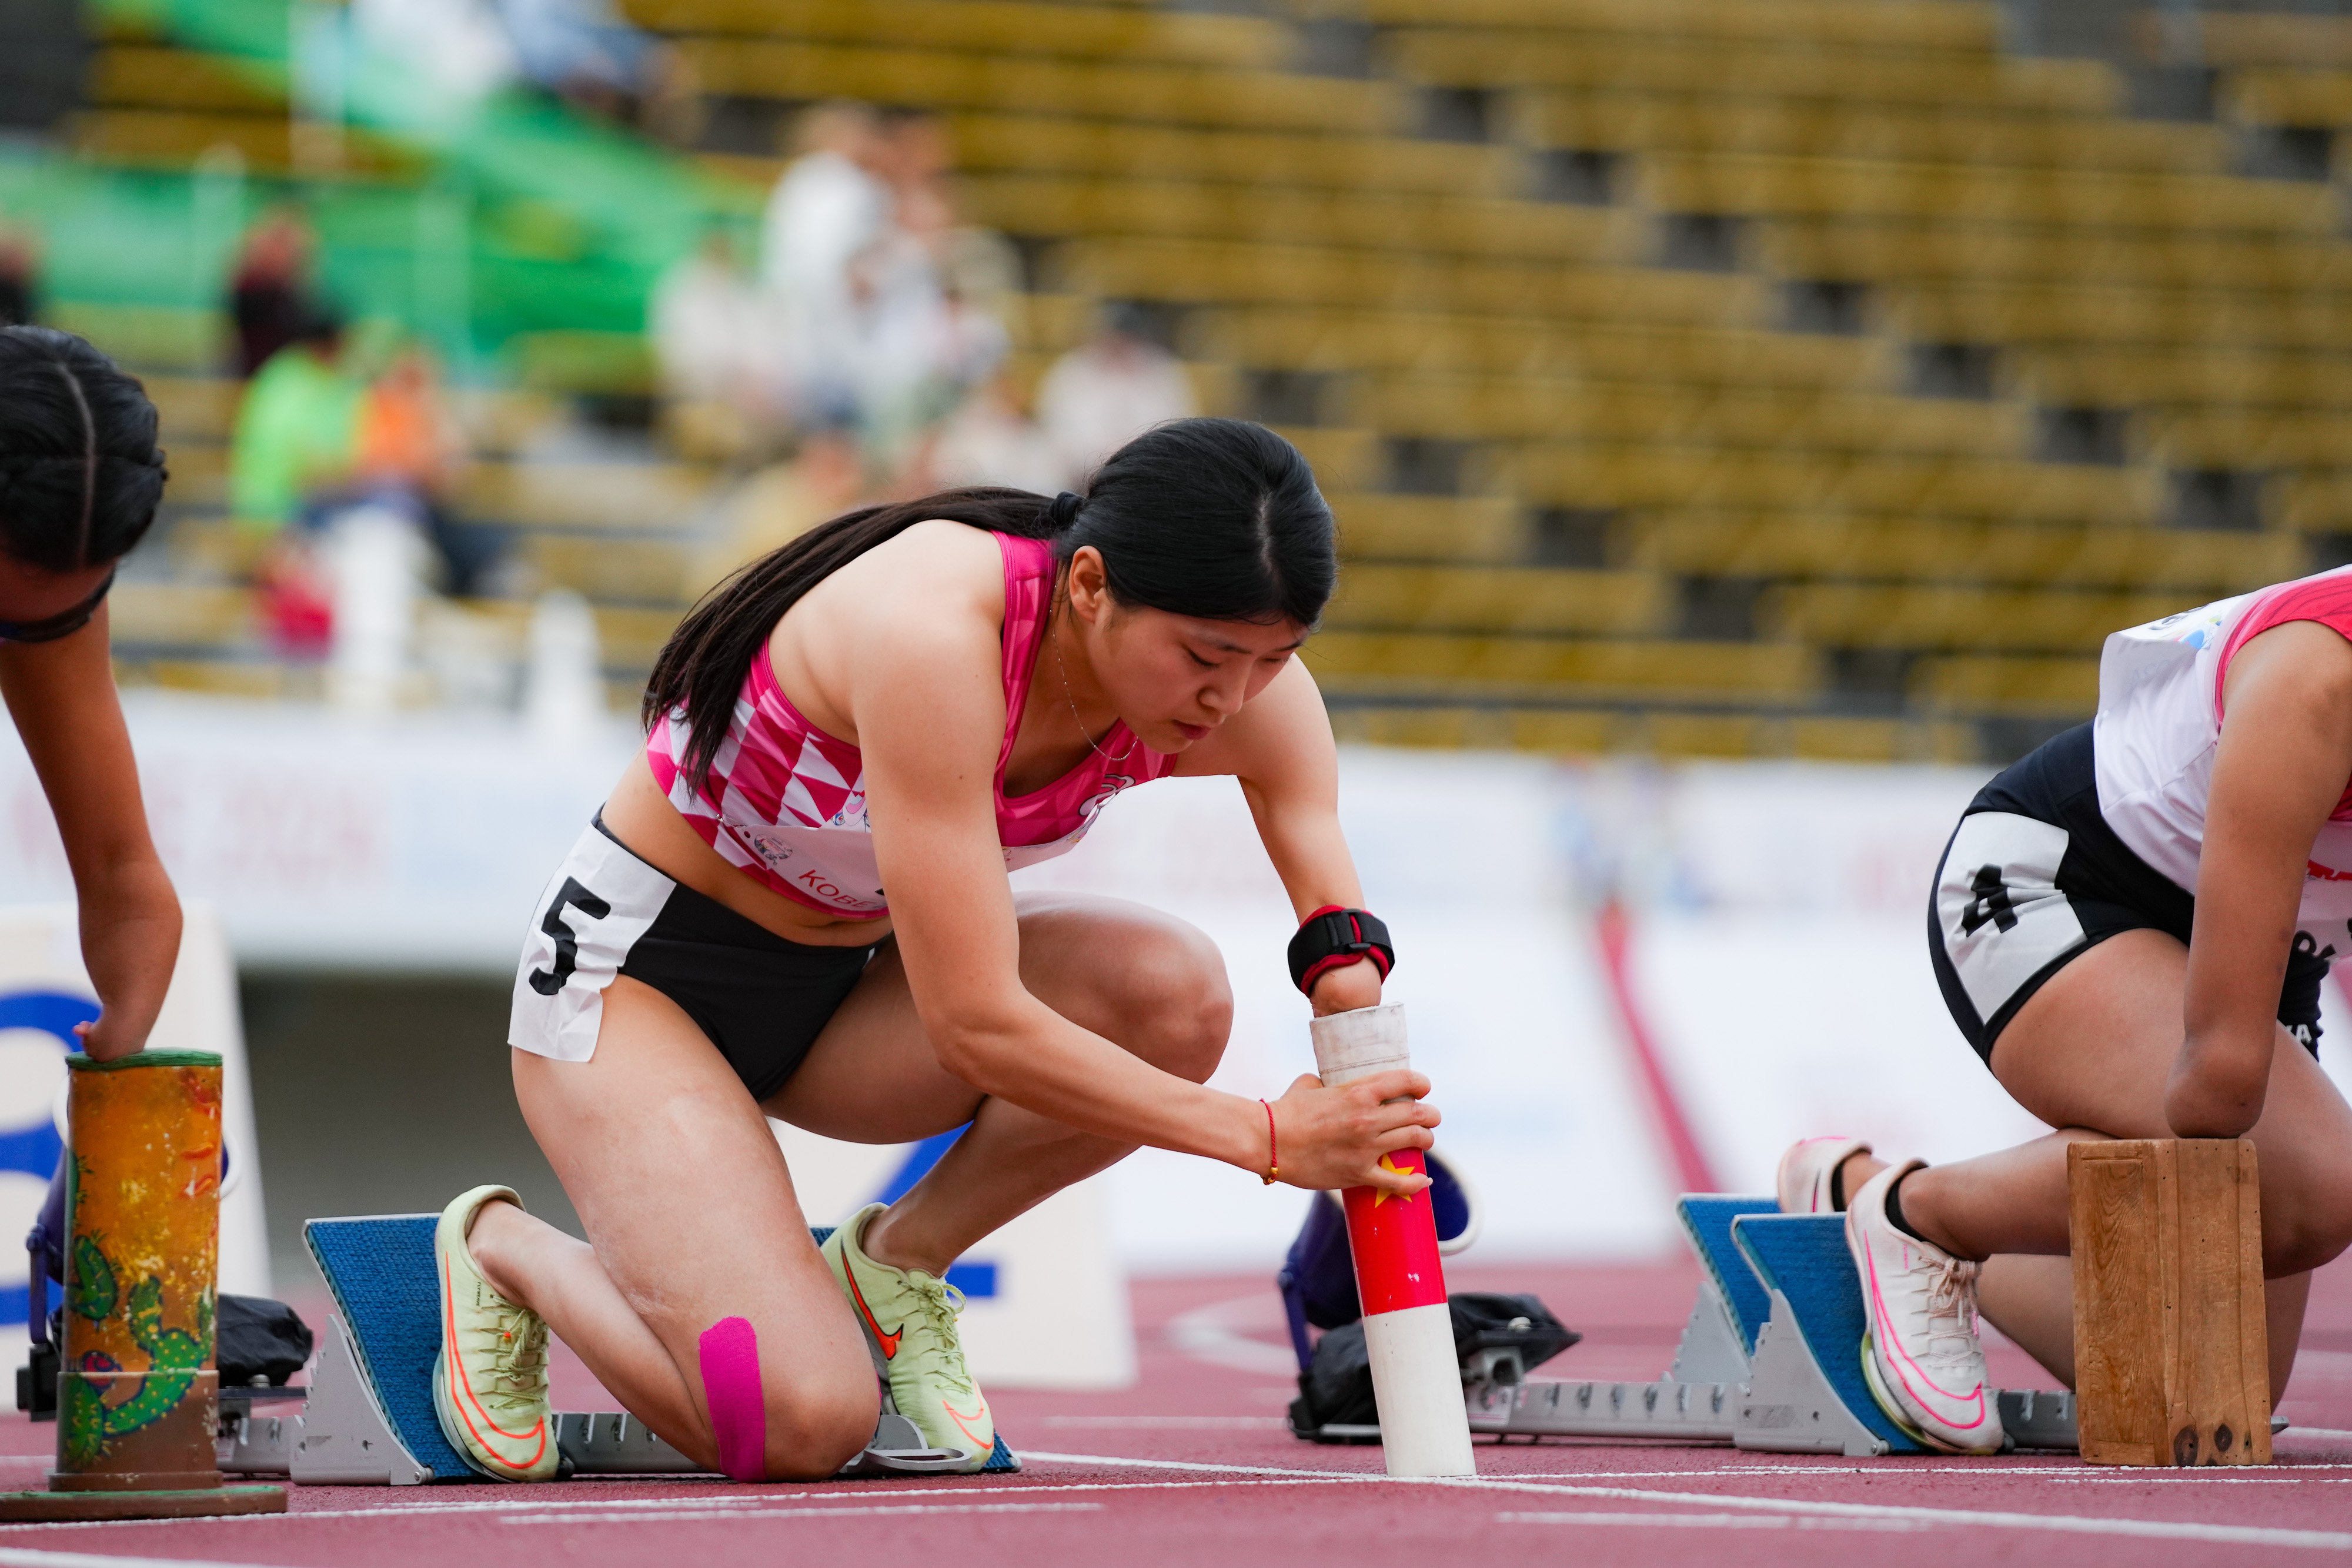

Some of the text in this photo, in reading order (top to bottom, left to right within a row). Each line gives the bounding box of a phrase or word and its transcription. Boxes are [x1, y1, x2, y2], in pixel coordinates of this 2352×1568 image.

[798, 869, 877, 908] KOBE
[1962, 862, 2018, 938] 4
[529, 875, 611, 995] 5
